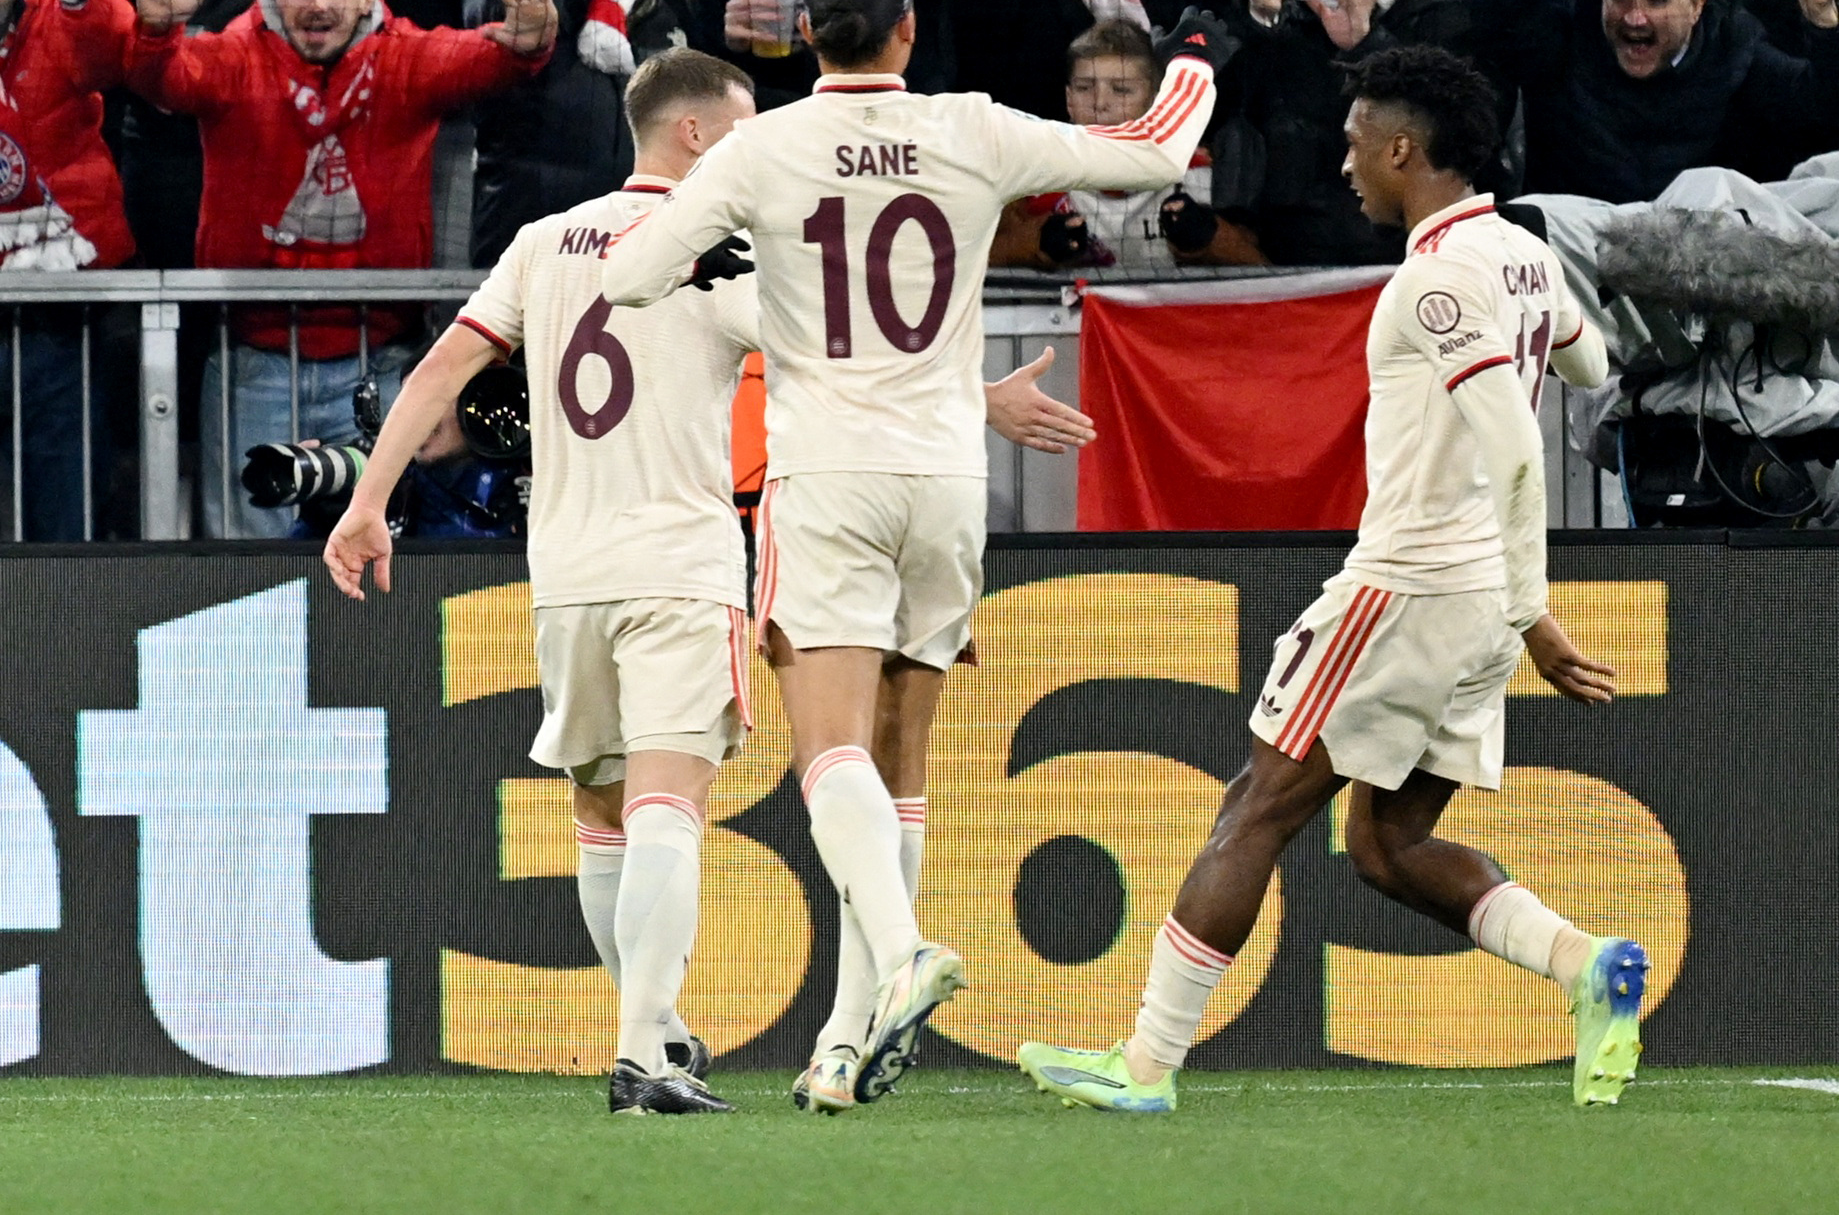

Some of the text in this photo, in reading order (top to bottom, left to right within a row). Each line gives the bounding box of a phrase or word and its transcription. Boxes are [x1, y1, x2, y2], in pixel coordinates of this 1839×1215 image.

[835, 138, 920, 178] SANÉ
[803, 192, 957, 359] 10
[558, 291, 635, 441] 6
[1277, 619, 1315, 690] 1
